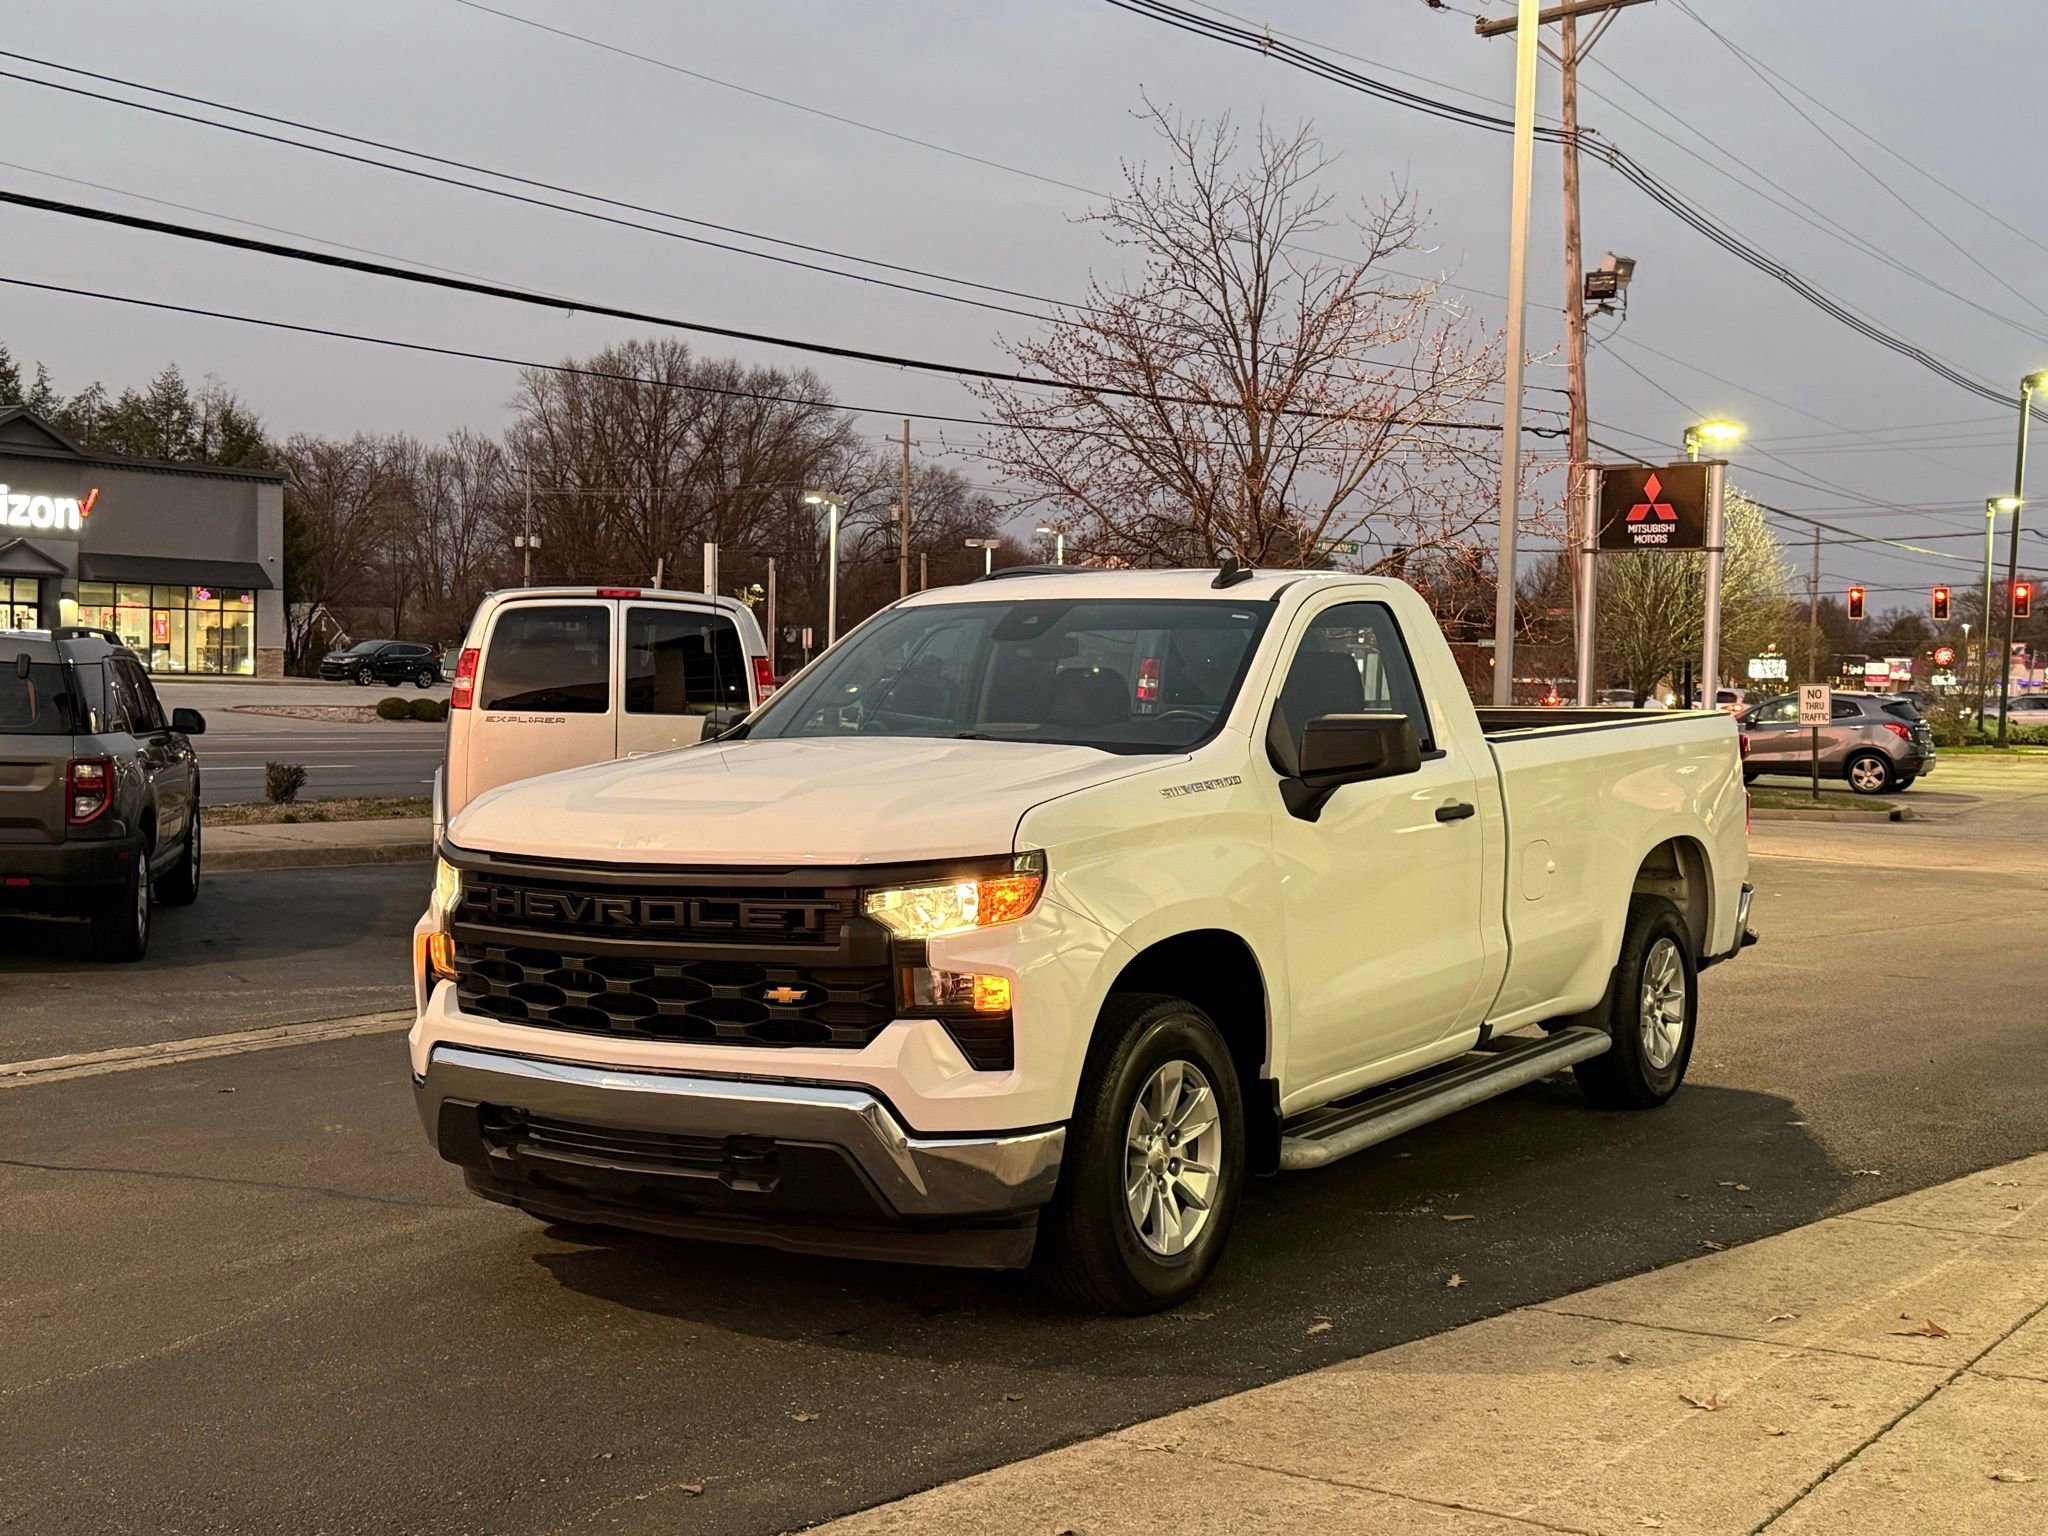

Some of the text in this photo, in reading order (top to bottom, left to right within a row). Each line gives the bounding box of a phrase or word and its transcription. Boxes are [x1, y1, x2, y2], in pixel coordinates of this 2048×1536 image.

[1627, 523, 1676, 534] MITSUBISHI
[1633, 534, 1669, 544] MOTORS
[1807, 689, 1822, 699] NO
[1805, 702, 1825, 710] THRU
[485, 716, 566, 724] EXPLORER
[1801, 712, 1829, 721] TRAFFIC
[1159, 775, 1242, 799] SILVERADO
[462, 882, 841, 930] CHEVROLET
